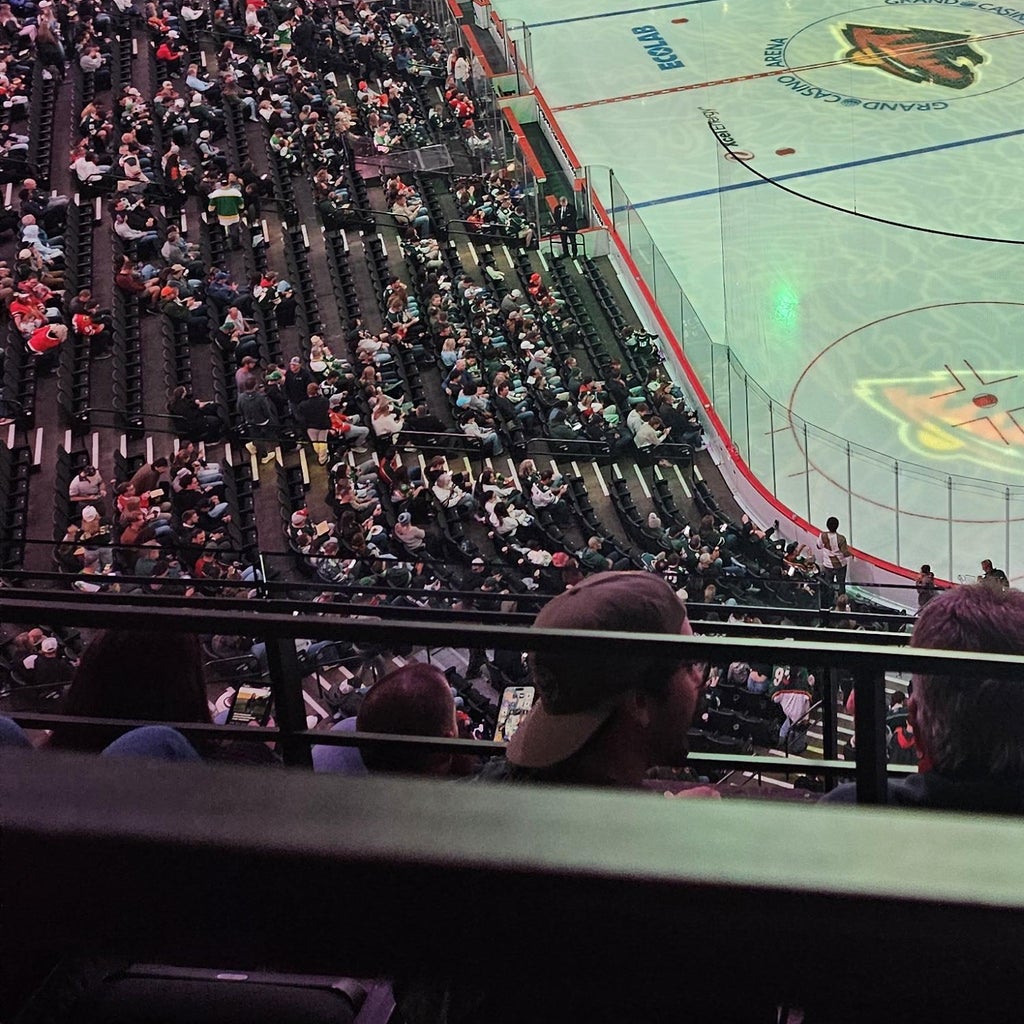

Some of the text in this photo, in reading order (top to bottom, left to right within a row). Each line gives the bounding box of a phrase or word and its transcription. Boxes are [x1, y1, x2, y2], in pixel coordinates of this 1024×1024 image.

[631, 24, 686, 72] ECOLAB
[764, 37, 949, 113] GRAND CASINO ARENA
